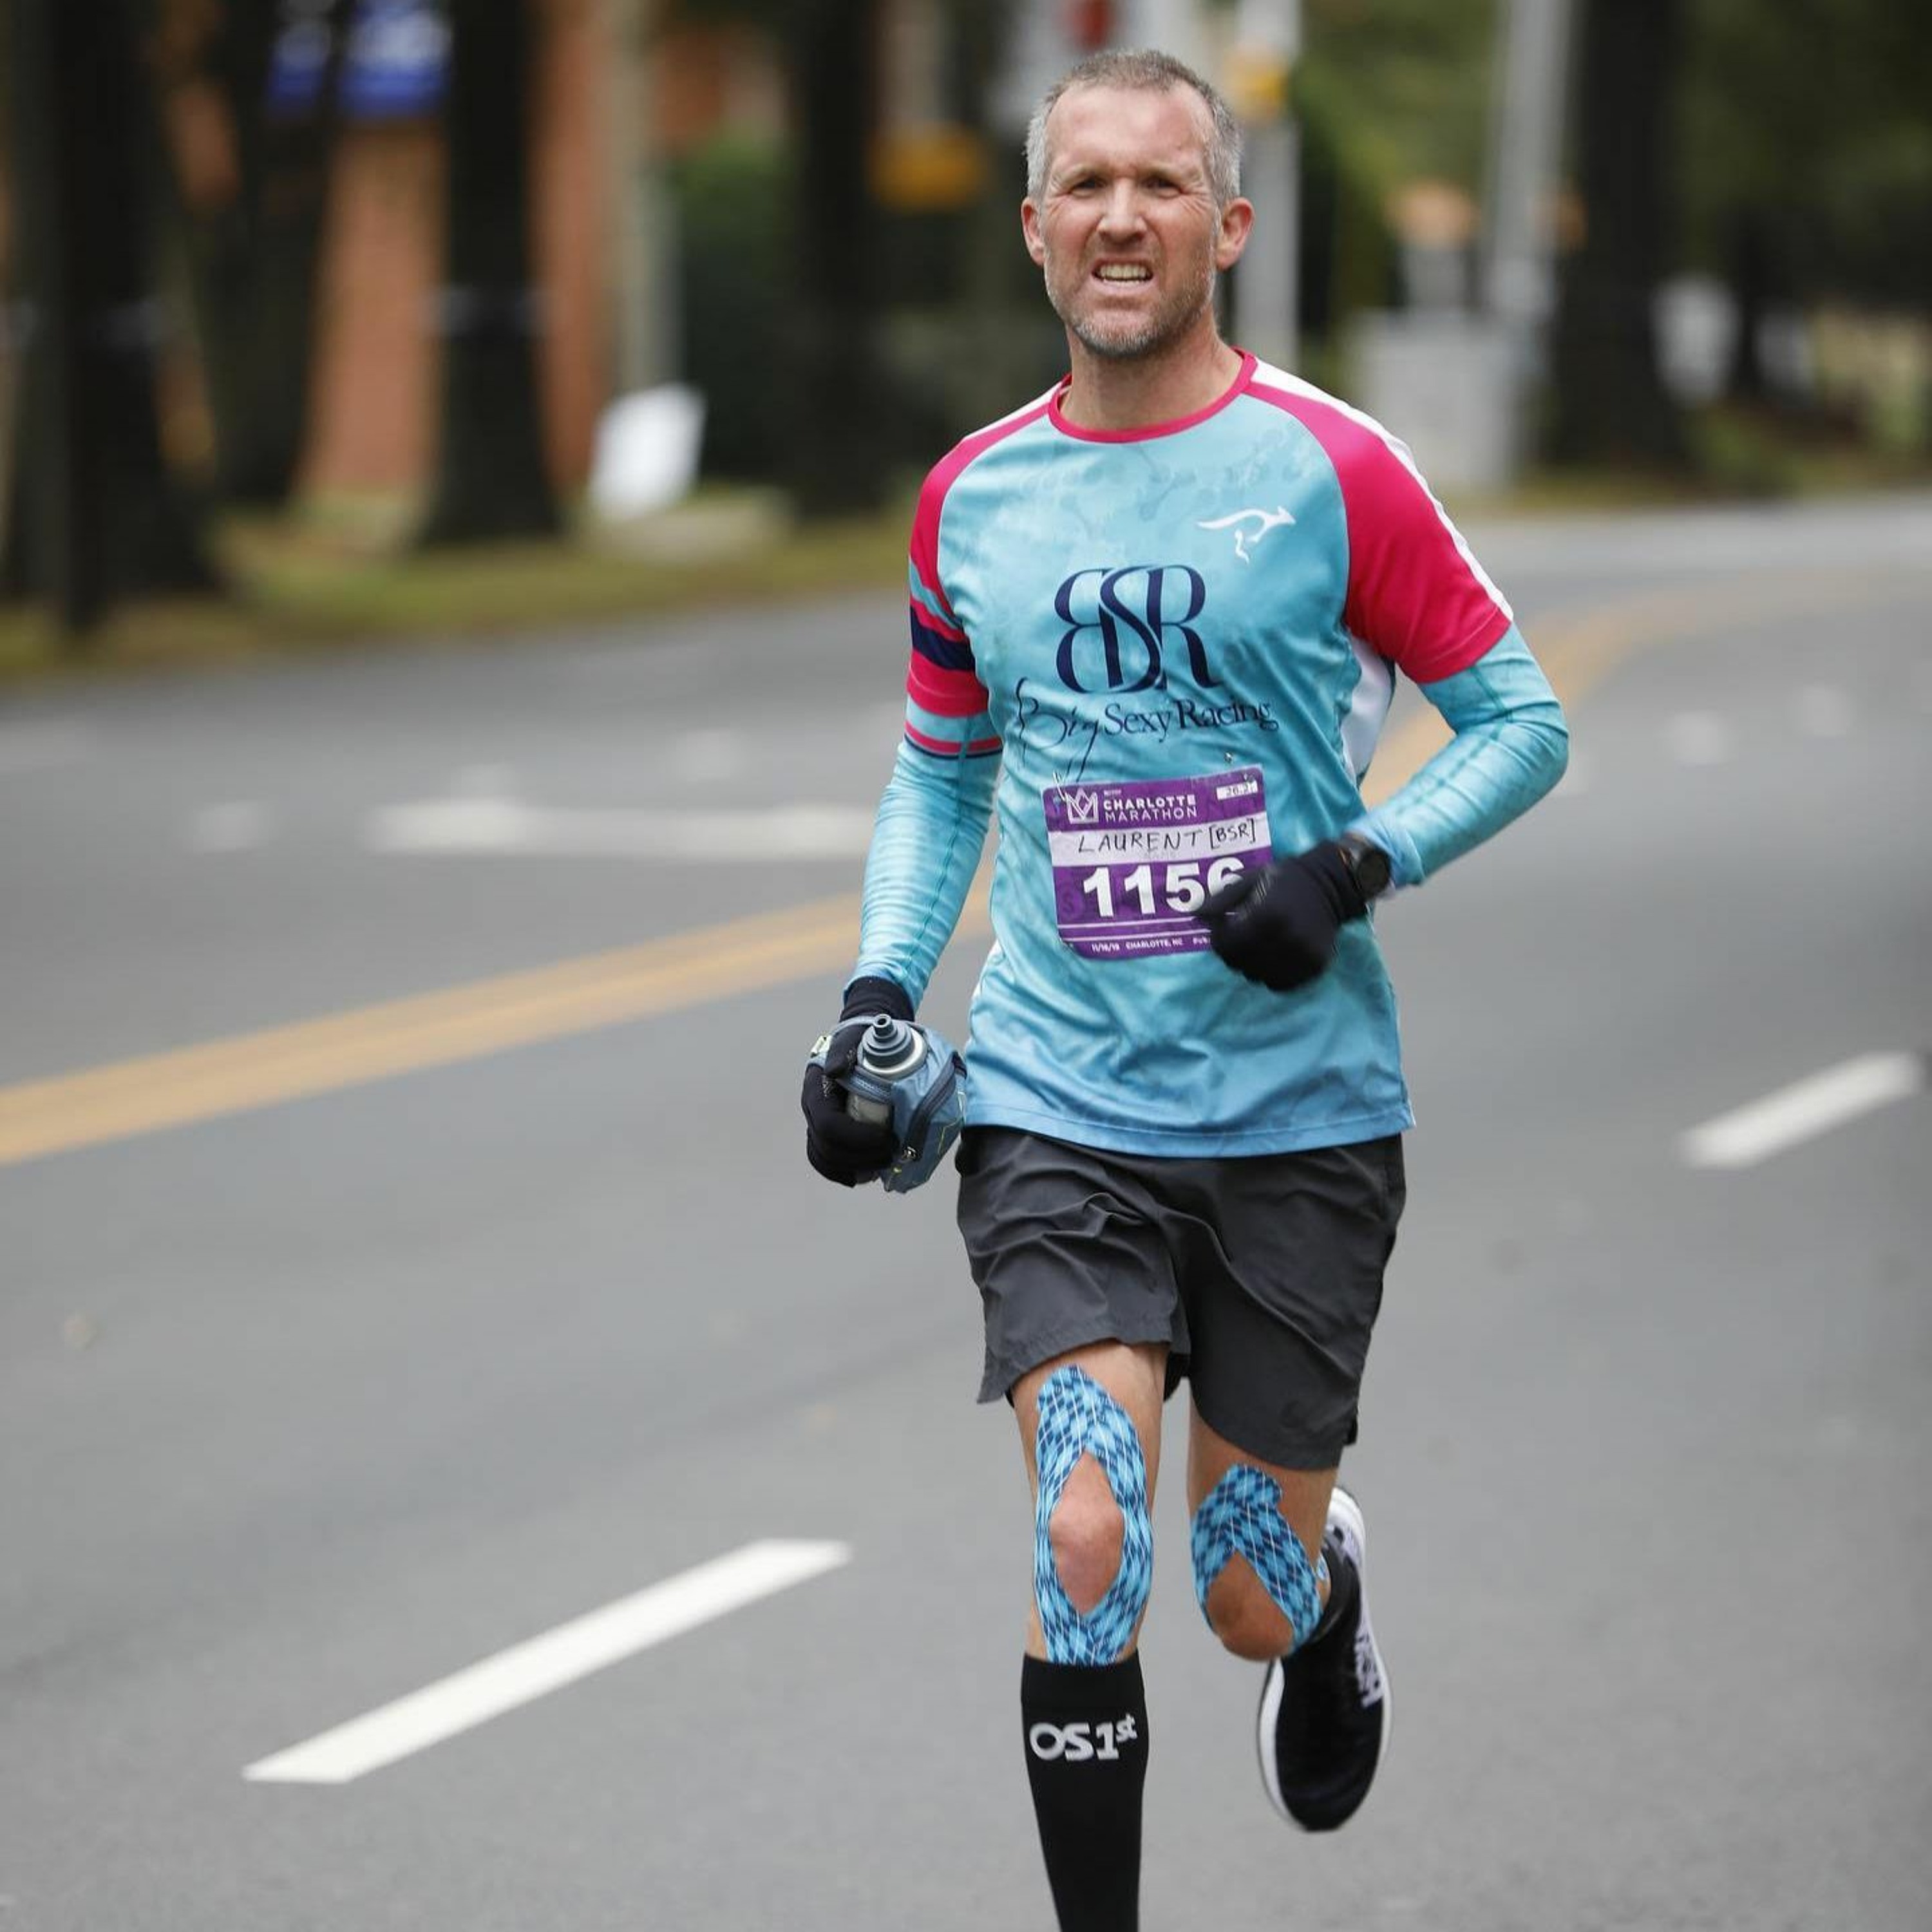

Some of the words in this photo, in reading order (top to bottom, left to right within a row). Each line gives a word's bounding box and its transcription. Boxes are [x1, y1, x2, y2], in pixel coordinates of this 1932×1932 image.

[1054, 564, 1221, 694] BSR
[1016, 677, 1099, 782] Big
[1104, 703, 1172, 742] Sexy
[1173, 696, 1279, 731] Racing
[1103, 794, 1196, 811] CHARLOTTE
[1104, 806, 1197, 823] MARATHON
[1078, 829, 1204, 853] LAURENT
[1030, 1713, 1138, 1761] OS1st
